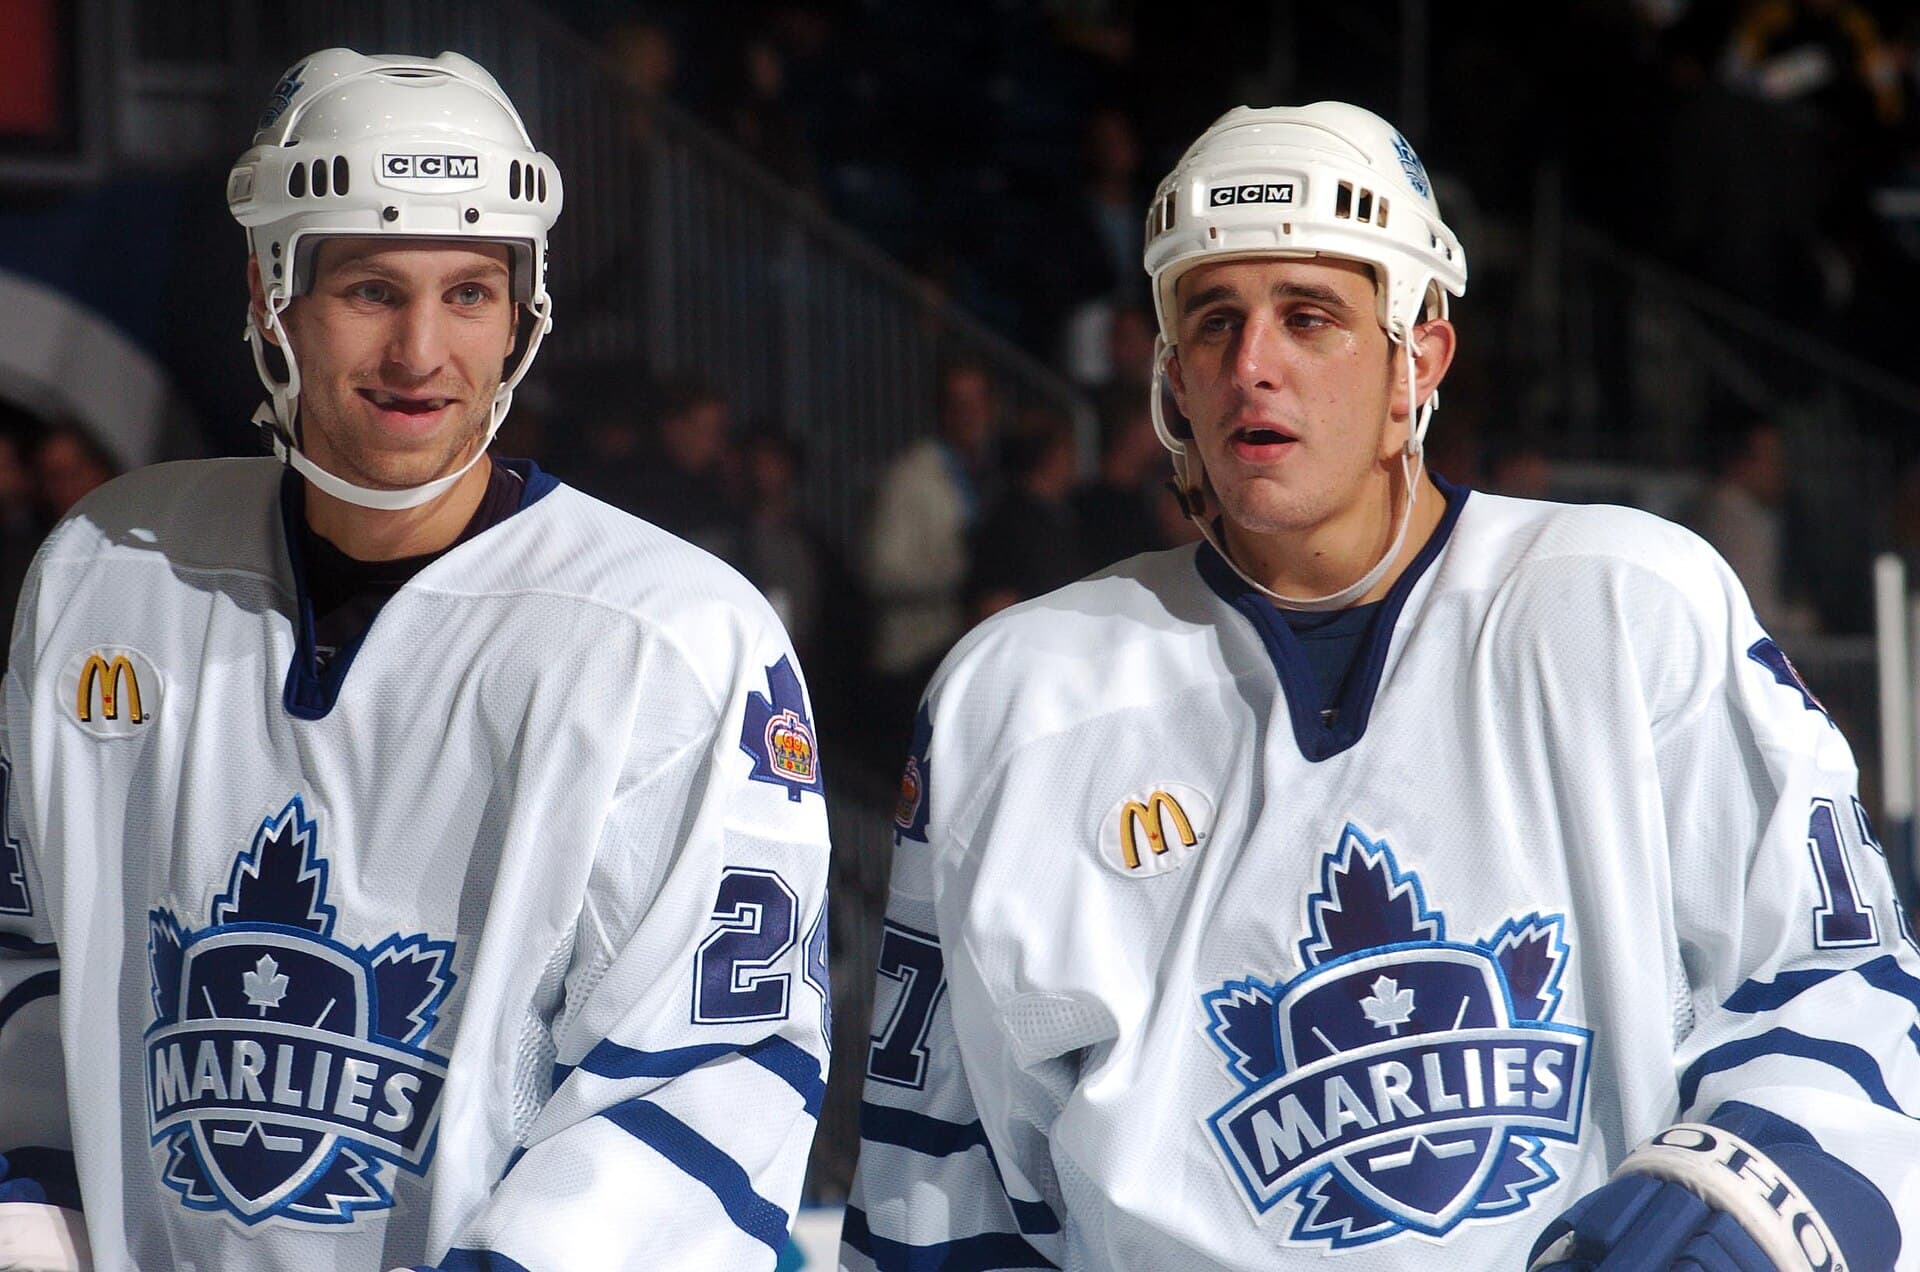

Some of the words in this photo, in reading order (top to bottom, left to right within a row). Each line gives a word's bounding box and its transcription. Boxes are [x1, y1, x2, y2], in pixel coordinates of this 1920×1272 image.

[386, 156, 478, 177] CCM
[1212, 185, 1292, 206] CCM
[1807, 795, 1920, 955] 1
[155, 1039, 422, 1133] MARLIES
[1251, 1048, 1564, 1175] MARLIES
